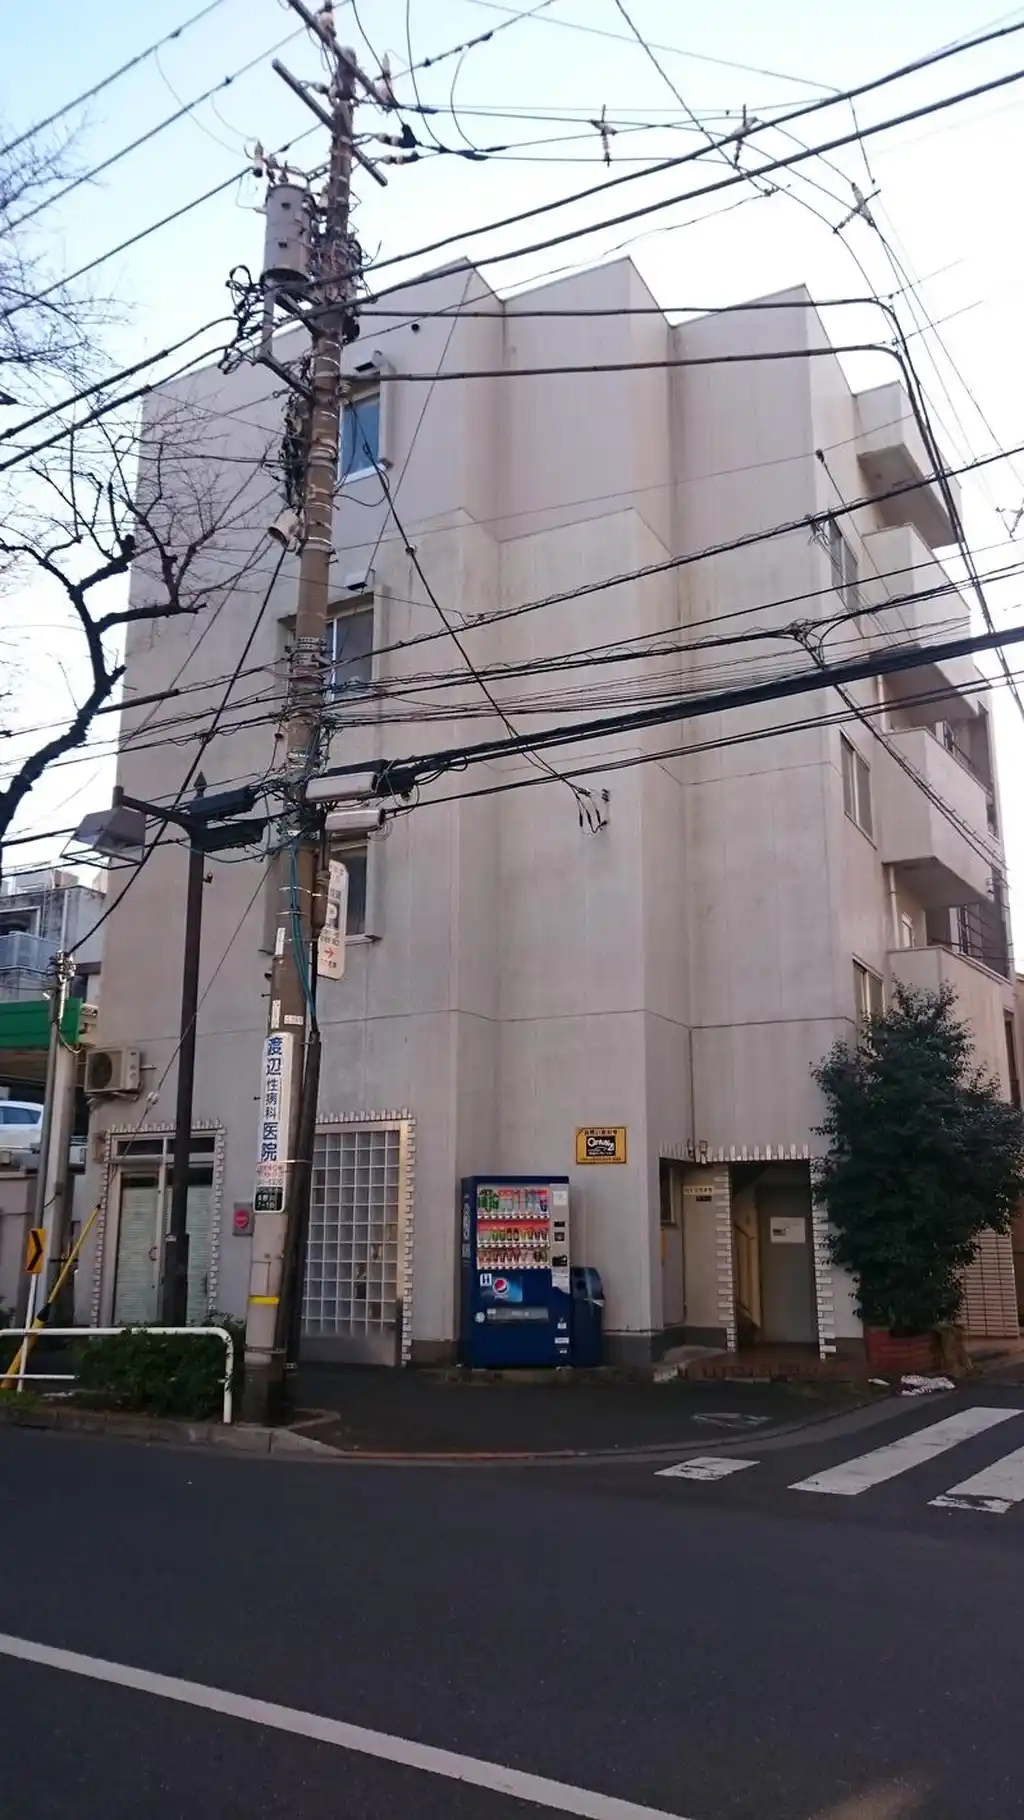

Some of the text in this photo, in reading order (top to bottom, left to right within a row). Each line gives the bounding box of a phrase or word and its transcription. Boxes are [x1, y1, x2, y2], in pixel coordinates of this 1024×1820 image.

[261, 1036, 284, 1162] 渡辺性病科医院
